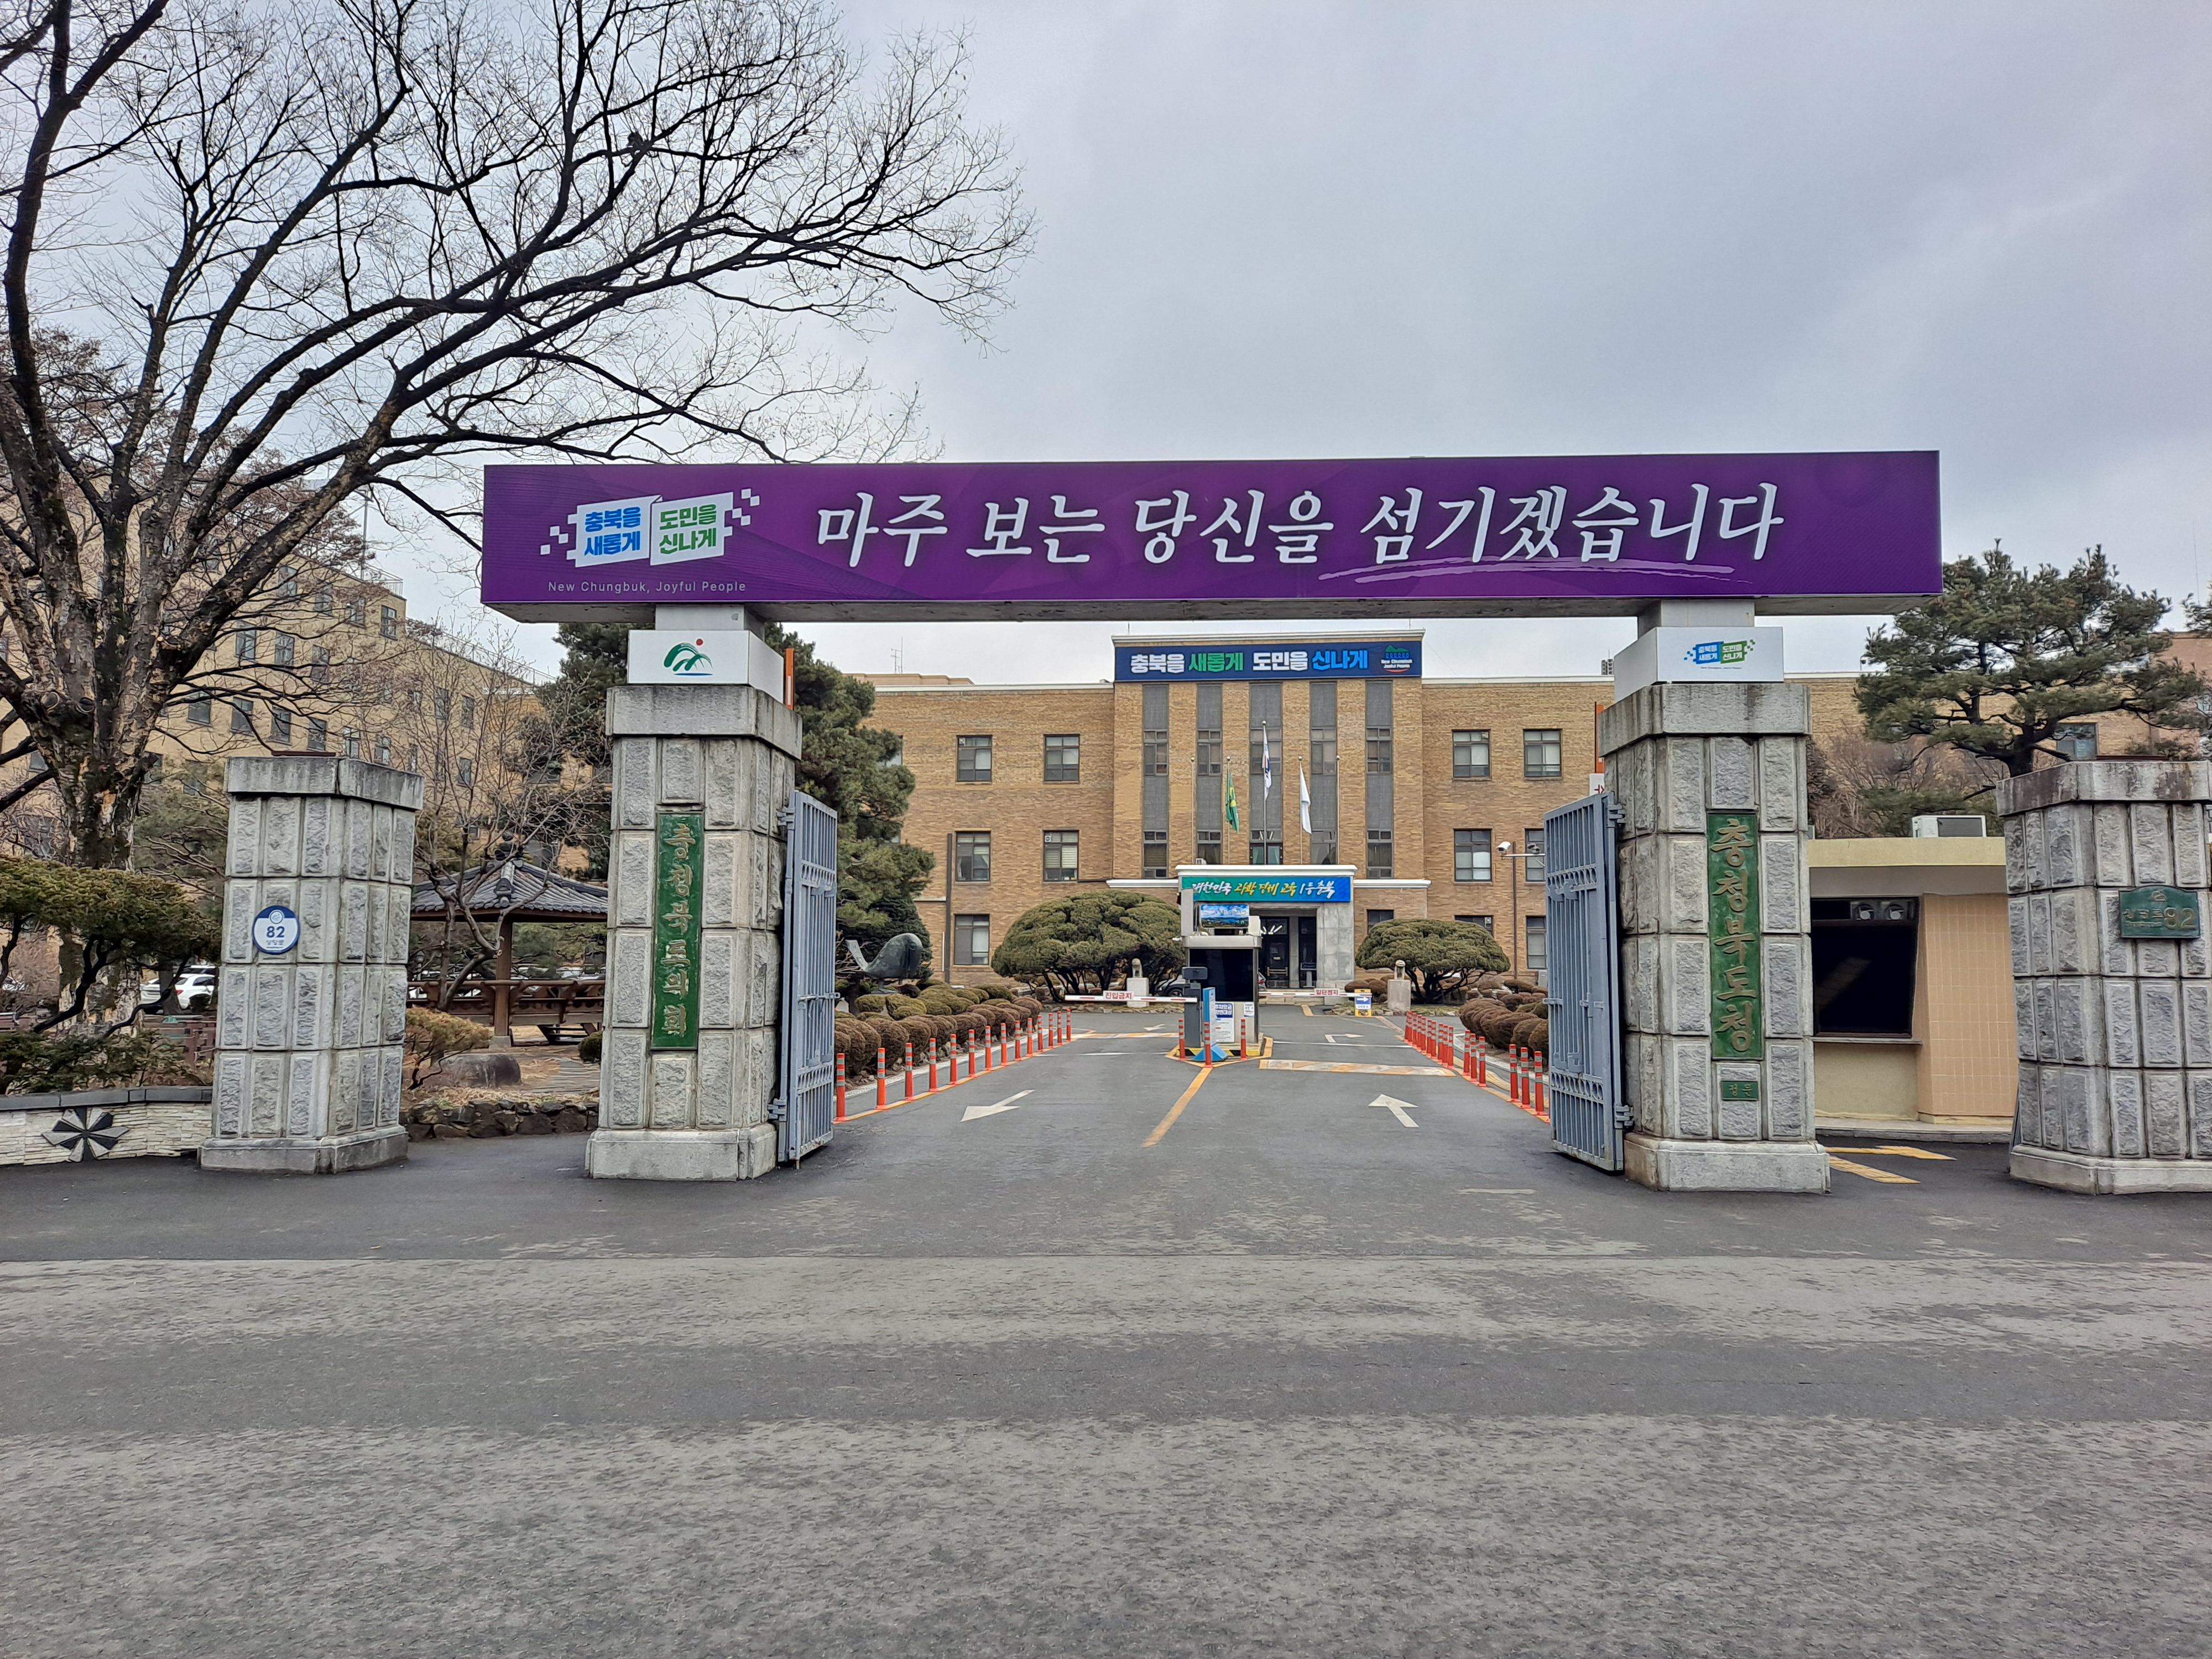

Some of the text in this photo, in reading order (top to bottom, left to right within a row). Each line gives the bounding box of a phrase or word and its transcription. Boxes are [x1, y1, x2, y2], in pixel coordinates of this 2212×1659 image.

[585, 506, 641, 533] 충북을
[659, 504, 717, 530] 도민을
[817, 483, 1785, 567] 마주 보는 당신을 섬기겠습니다
[584, 530, 641, 556] 새롭게
[659, 527, 717, 555] 신나게
[548, 581, 746, 594] New Chungbuk, Joyful People
[1131, 649, 1368, 674] 충북을 새롭게 도민을 신나게
[2163, 907, 2196, 930] 82
[267, 926, 285, 938] 82
[1710, 818, 1757, 1052] 충청북도청
[1729, 1083, 1753, 1096] 정문
